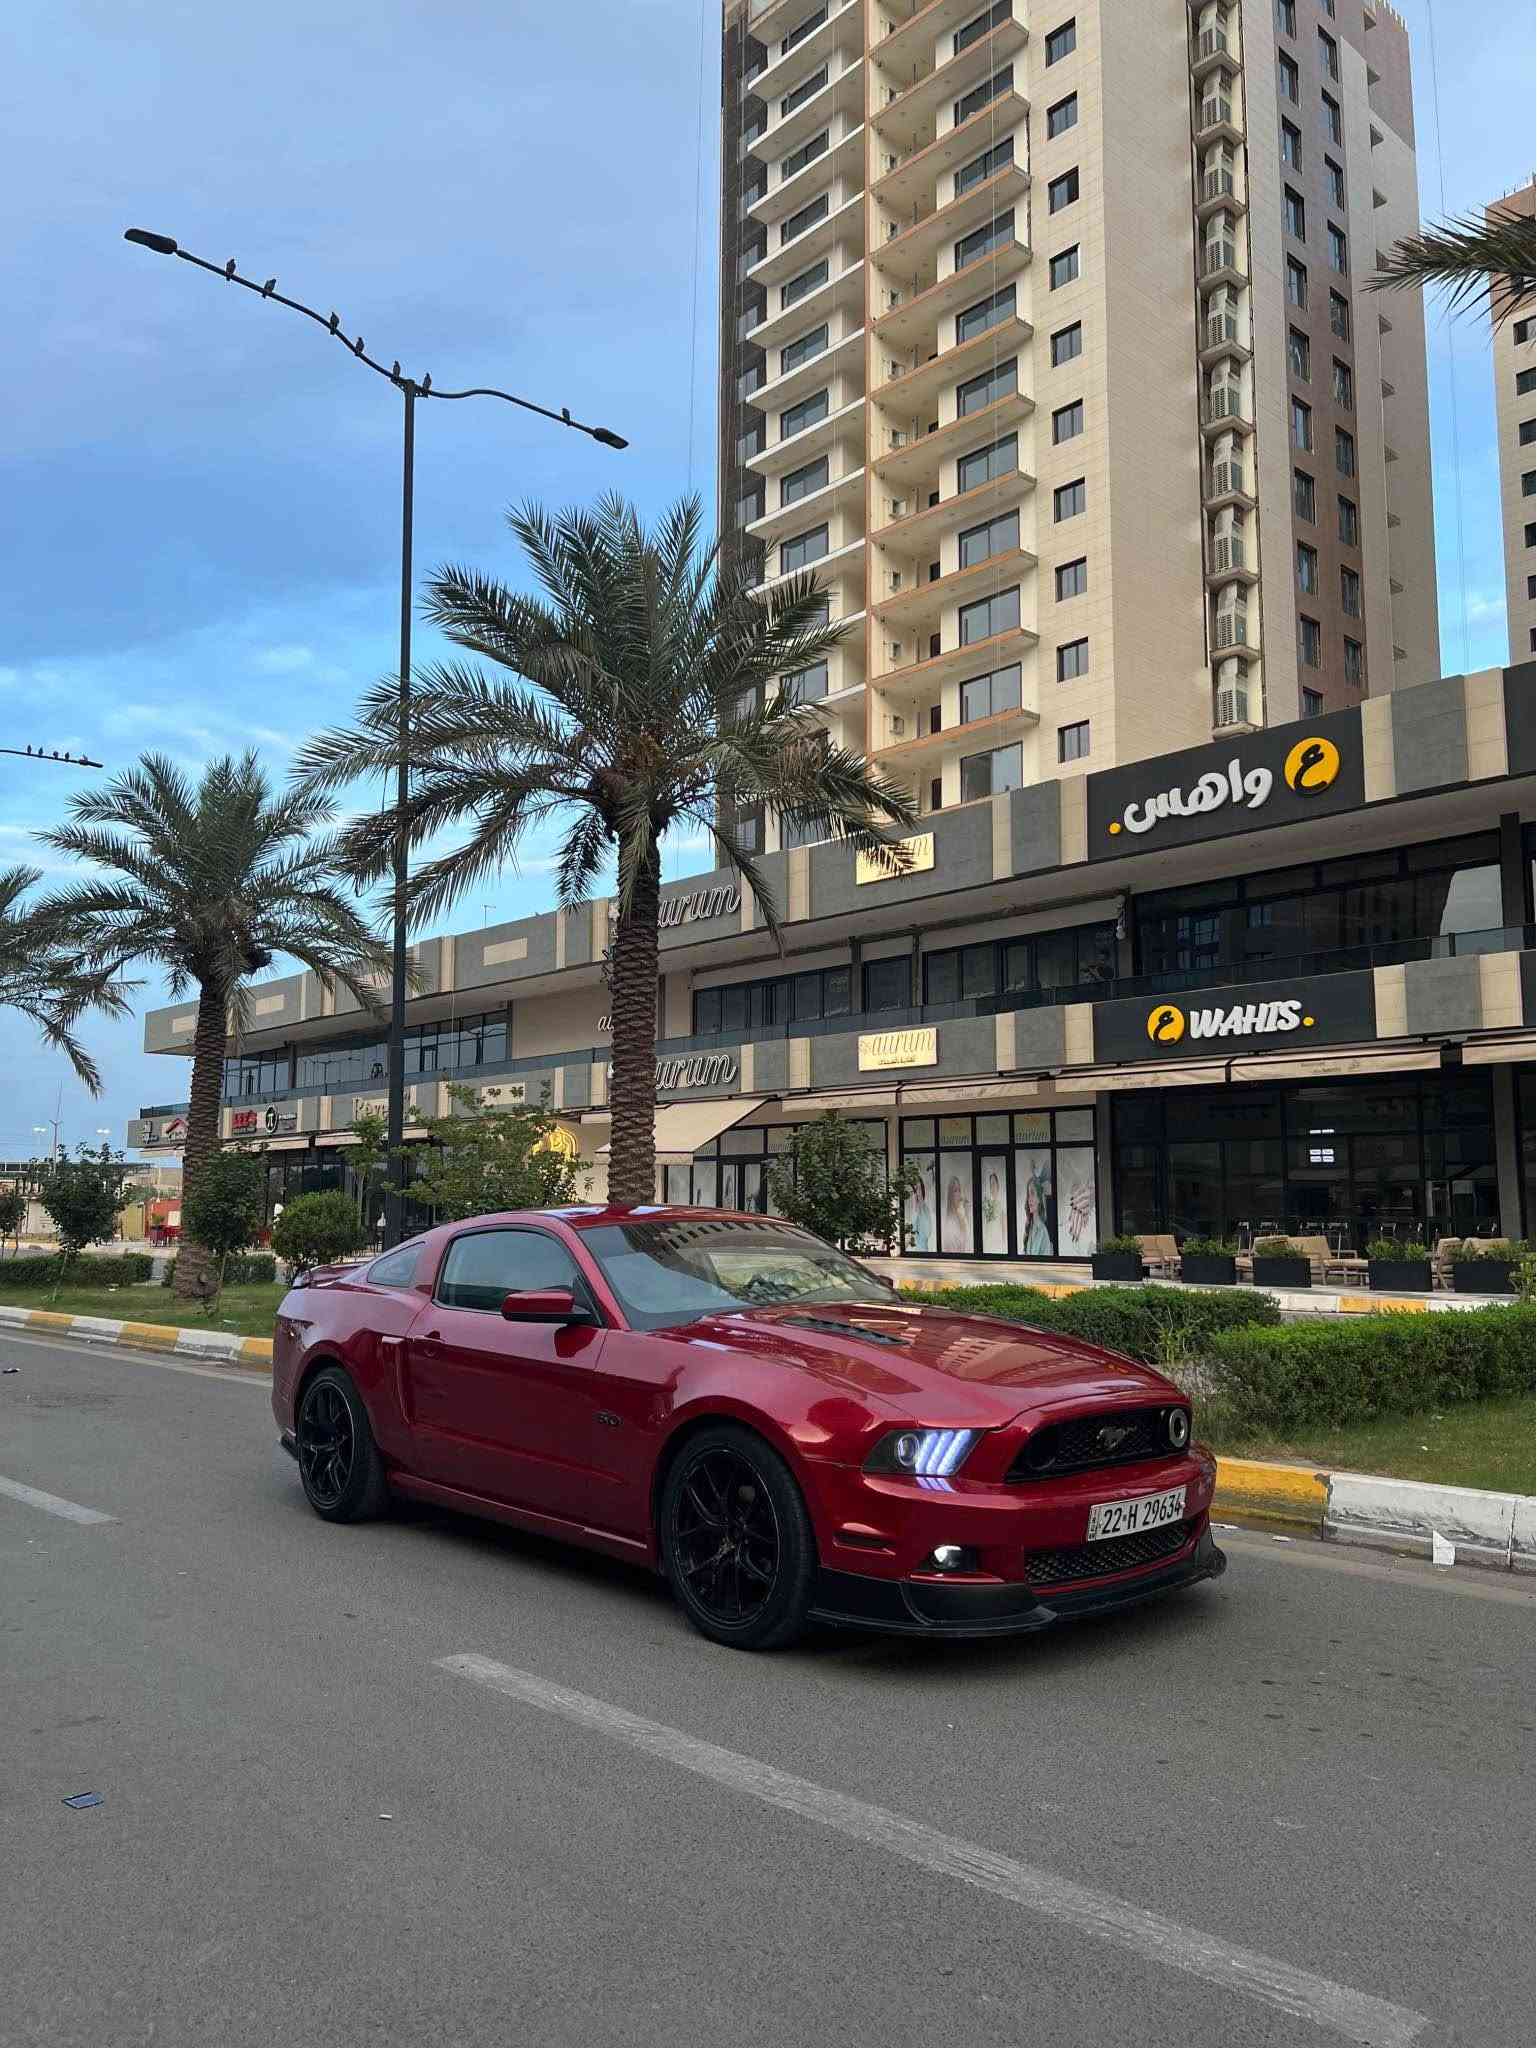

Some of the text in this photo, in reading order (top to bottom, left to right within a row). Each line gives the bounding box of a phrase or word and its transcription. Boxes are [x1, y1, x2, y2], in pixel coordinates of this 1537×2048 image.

[657, 884, 741, 928] urum
[655, 1054, 737, 1090] urum
[1142, 1493, 1182, 1526] 29634
